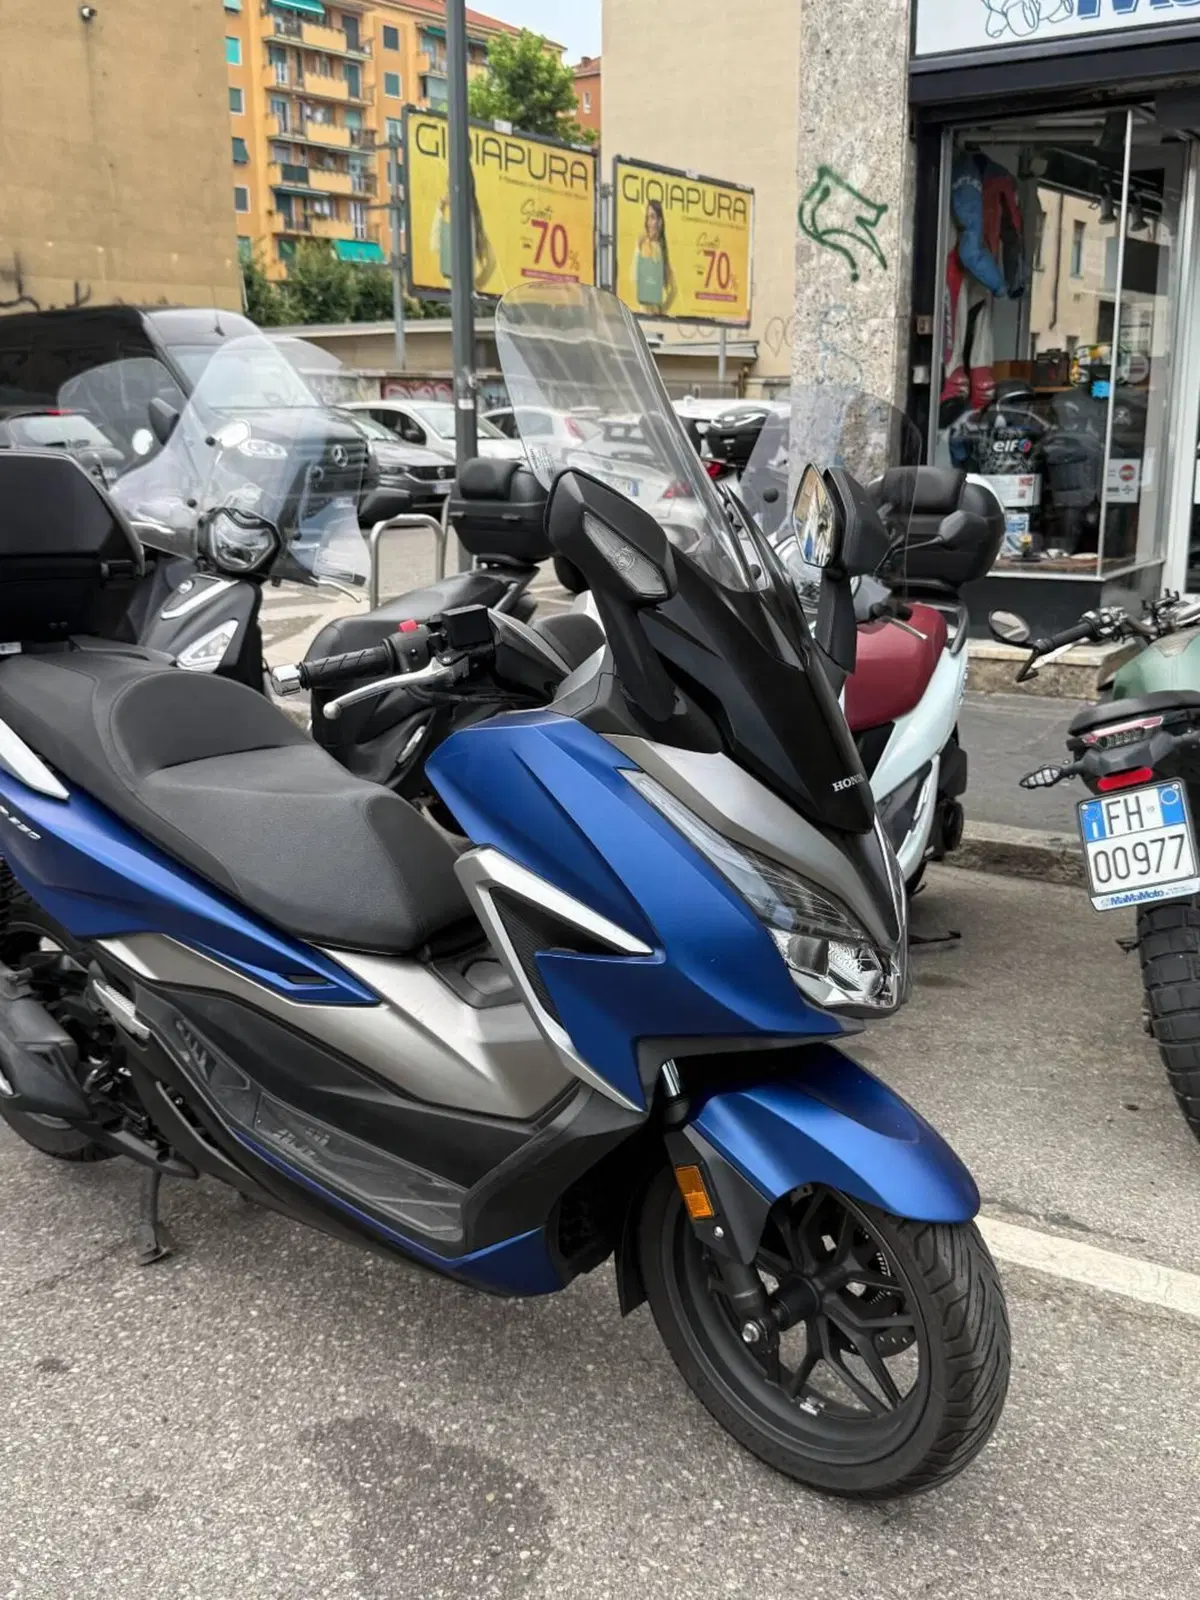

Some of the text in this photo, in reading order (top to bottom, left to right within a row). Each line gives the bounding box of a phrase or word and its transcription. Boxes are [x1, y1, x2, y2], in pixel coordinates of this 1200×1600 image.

[416, 123, 588, 191] GIIAPURA
[993, 440, 1019, 452] elf
[1105, 796, 1144, 834] FH
[1093, 833, 1185, 884] 00977
